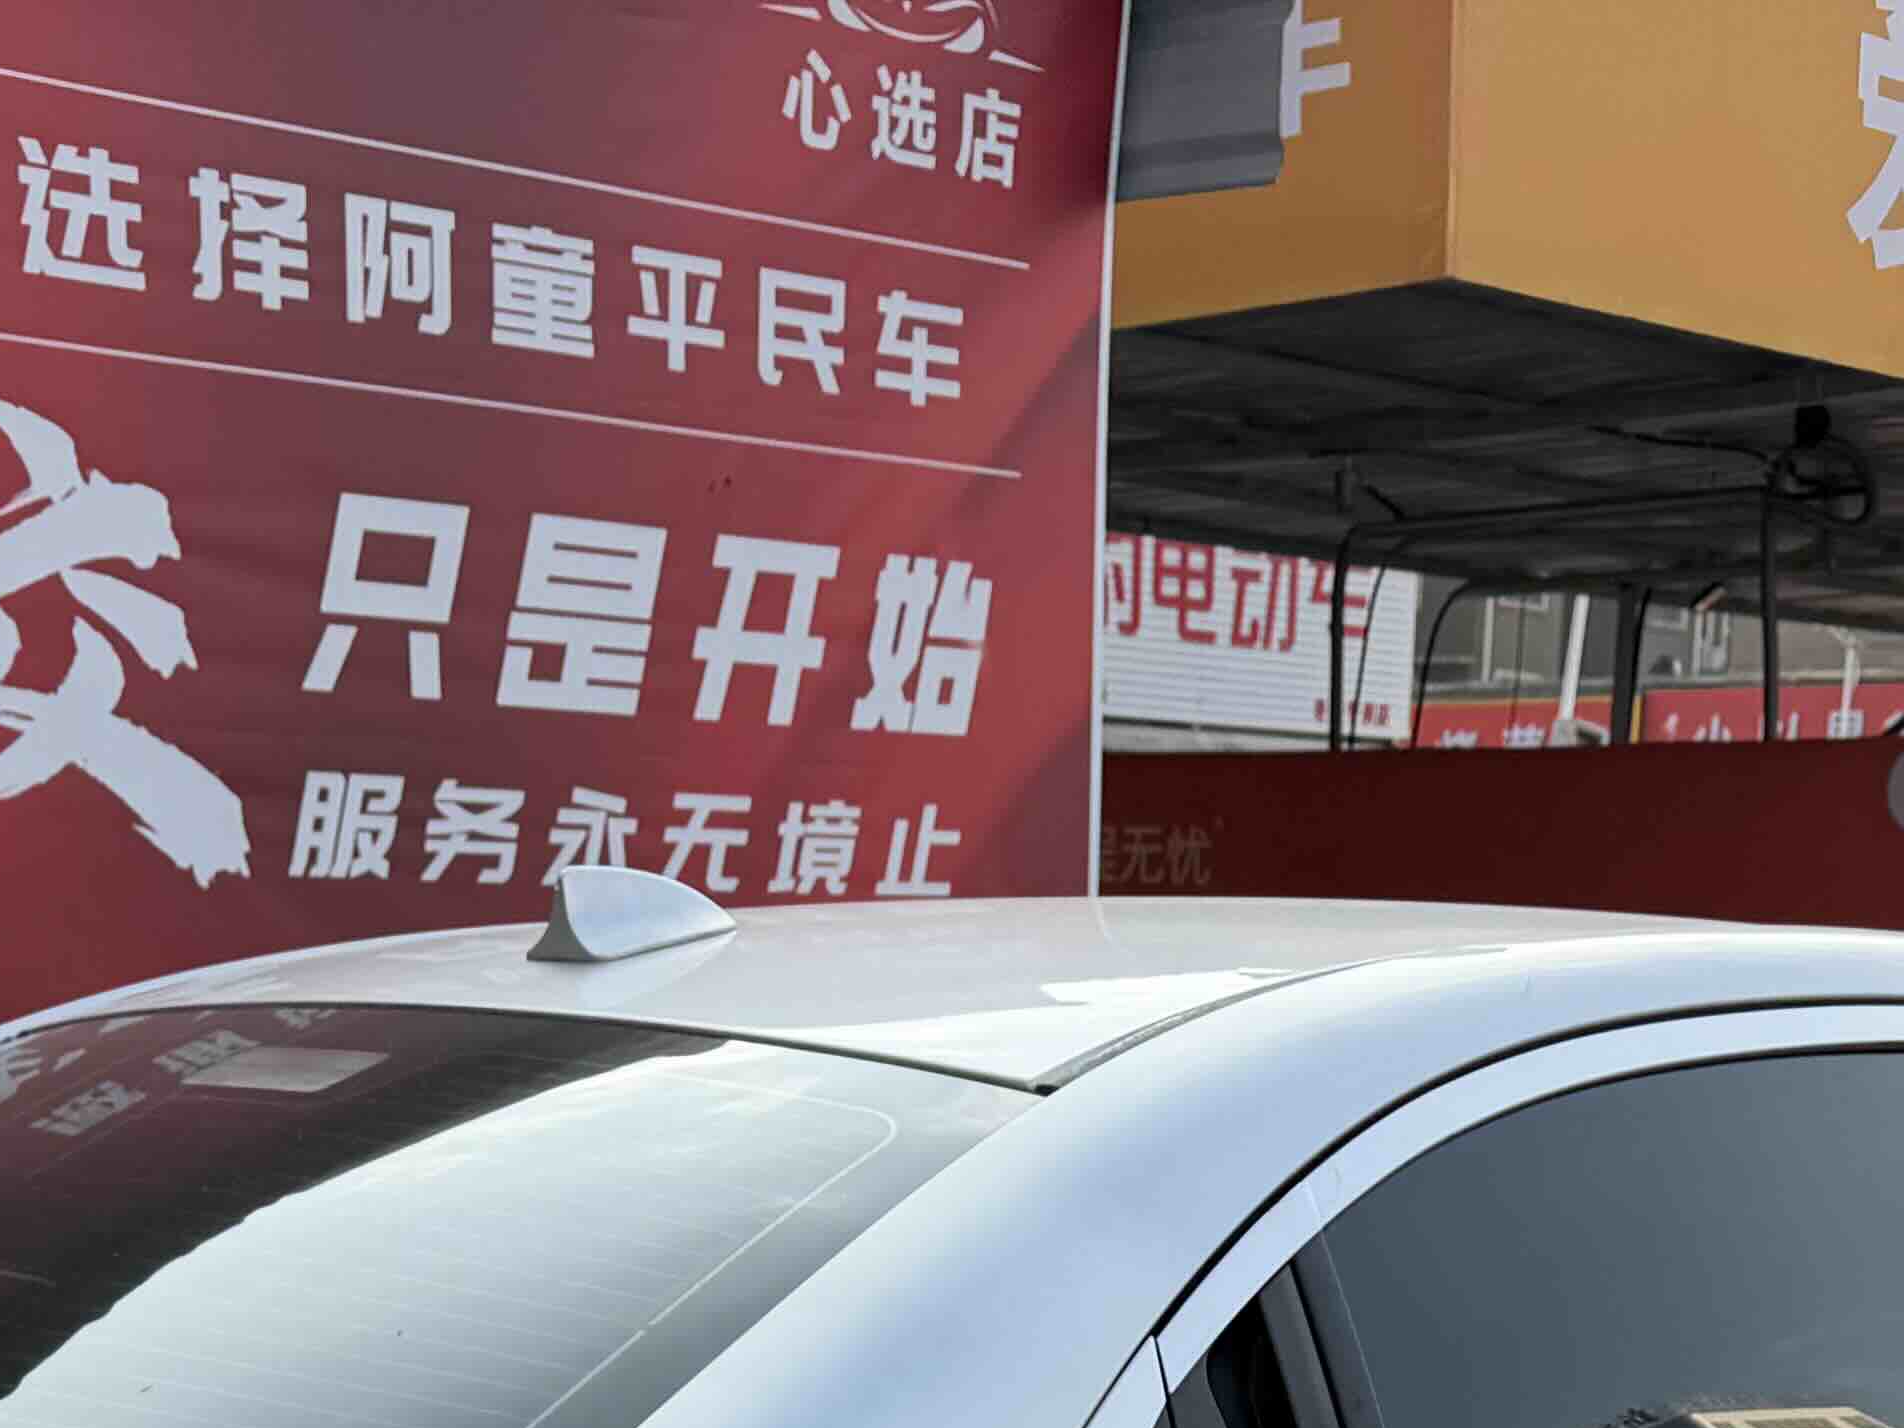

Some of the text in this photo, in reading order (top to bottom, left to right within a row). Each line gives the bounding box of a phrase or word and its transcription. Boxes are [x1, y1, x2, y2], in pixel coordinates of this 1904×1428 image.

[781, 48, 1022, 189] 心选店
[301, 490, 995, 738] 只是开始
[287, 769, 961, 897] 服务永无境止
